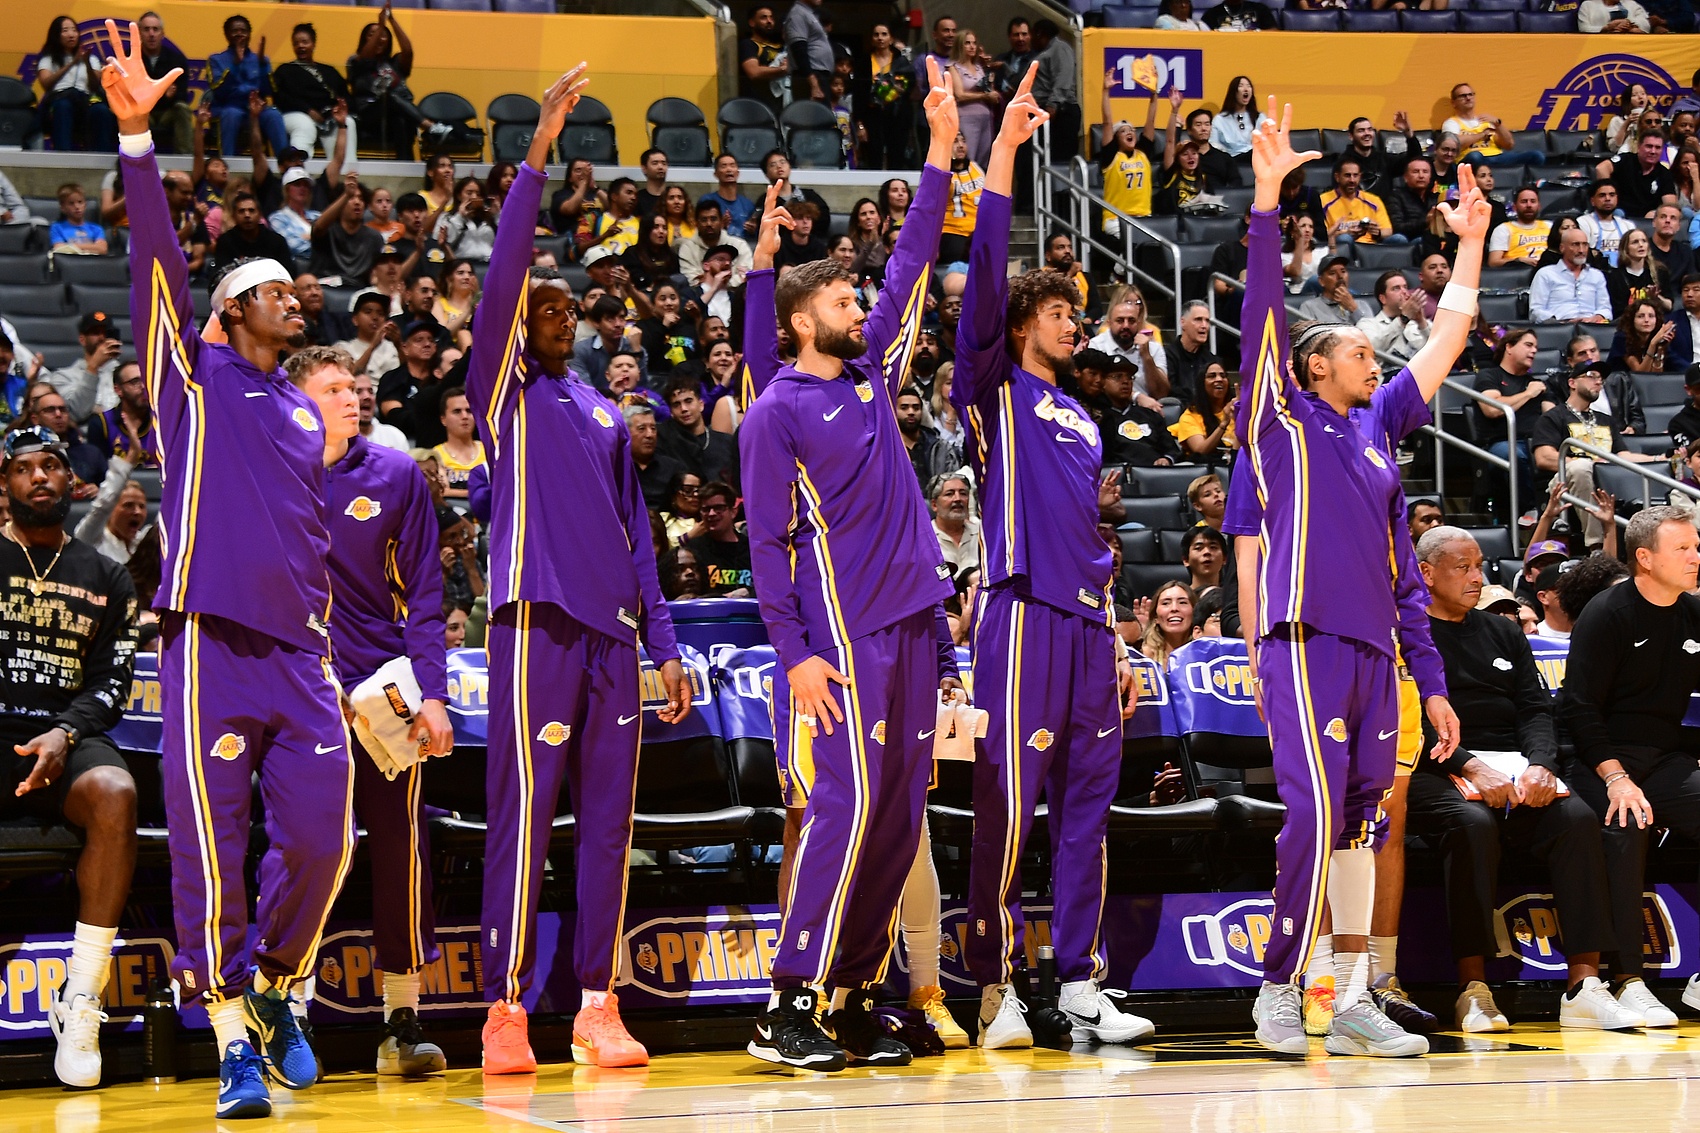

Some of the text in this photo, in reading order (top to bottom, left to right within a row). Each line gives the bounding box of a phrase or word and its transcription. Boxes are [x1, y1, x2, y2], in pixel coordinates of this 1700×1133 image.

[1126, 172, 1144, 188] 77
[1033, 389, 1097, 447] LAKERS
[17, 630, 31, 642] IS
[8, 658, 37, 670] NAME
[43, 663, 56, 675] IS
[656, 928, 778, 983] PRIME
